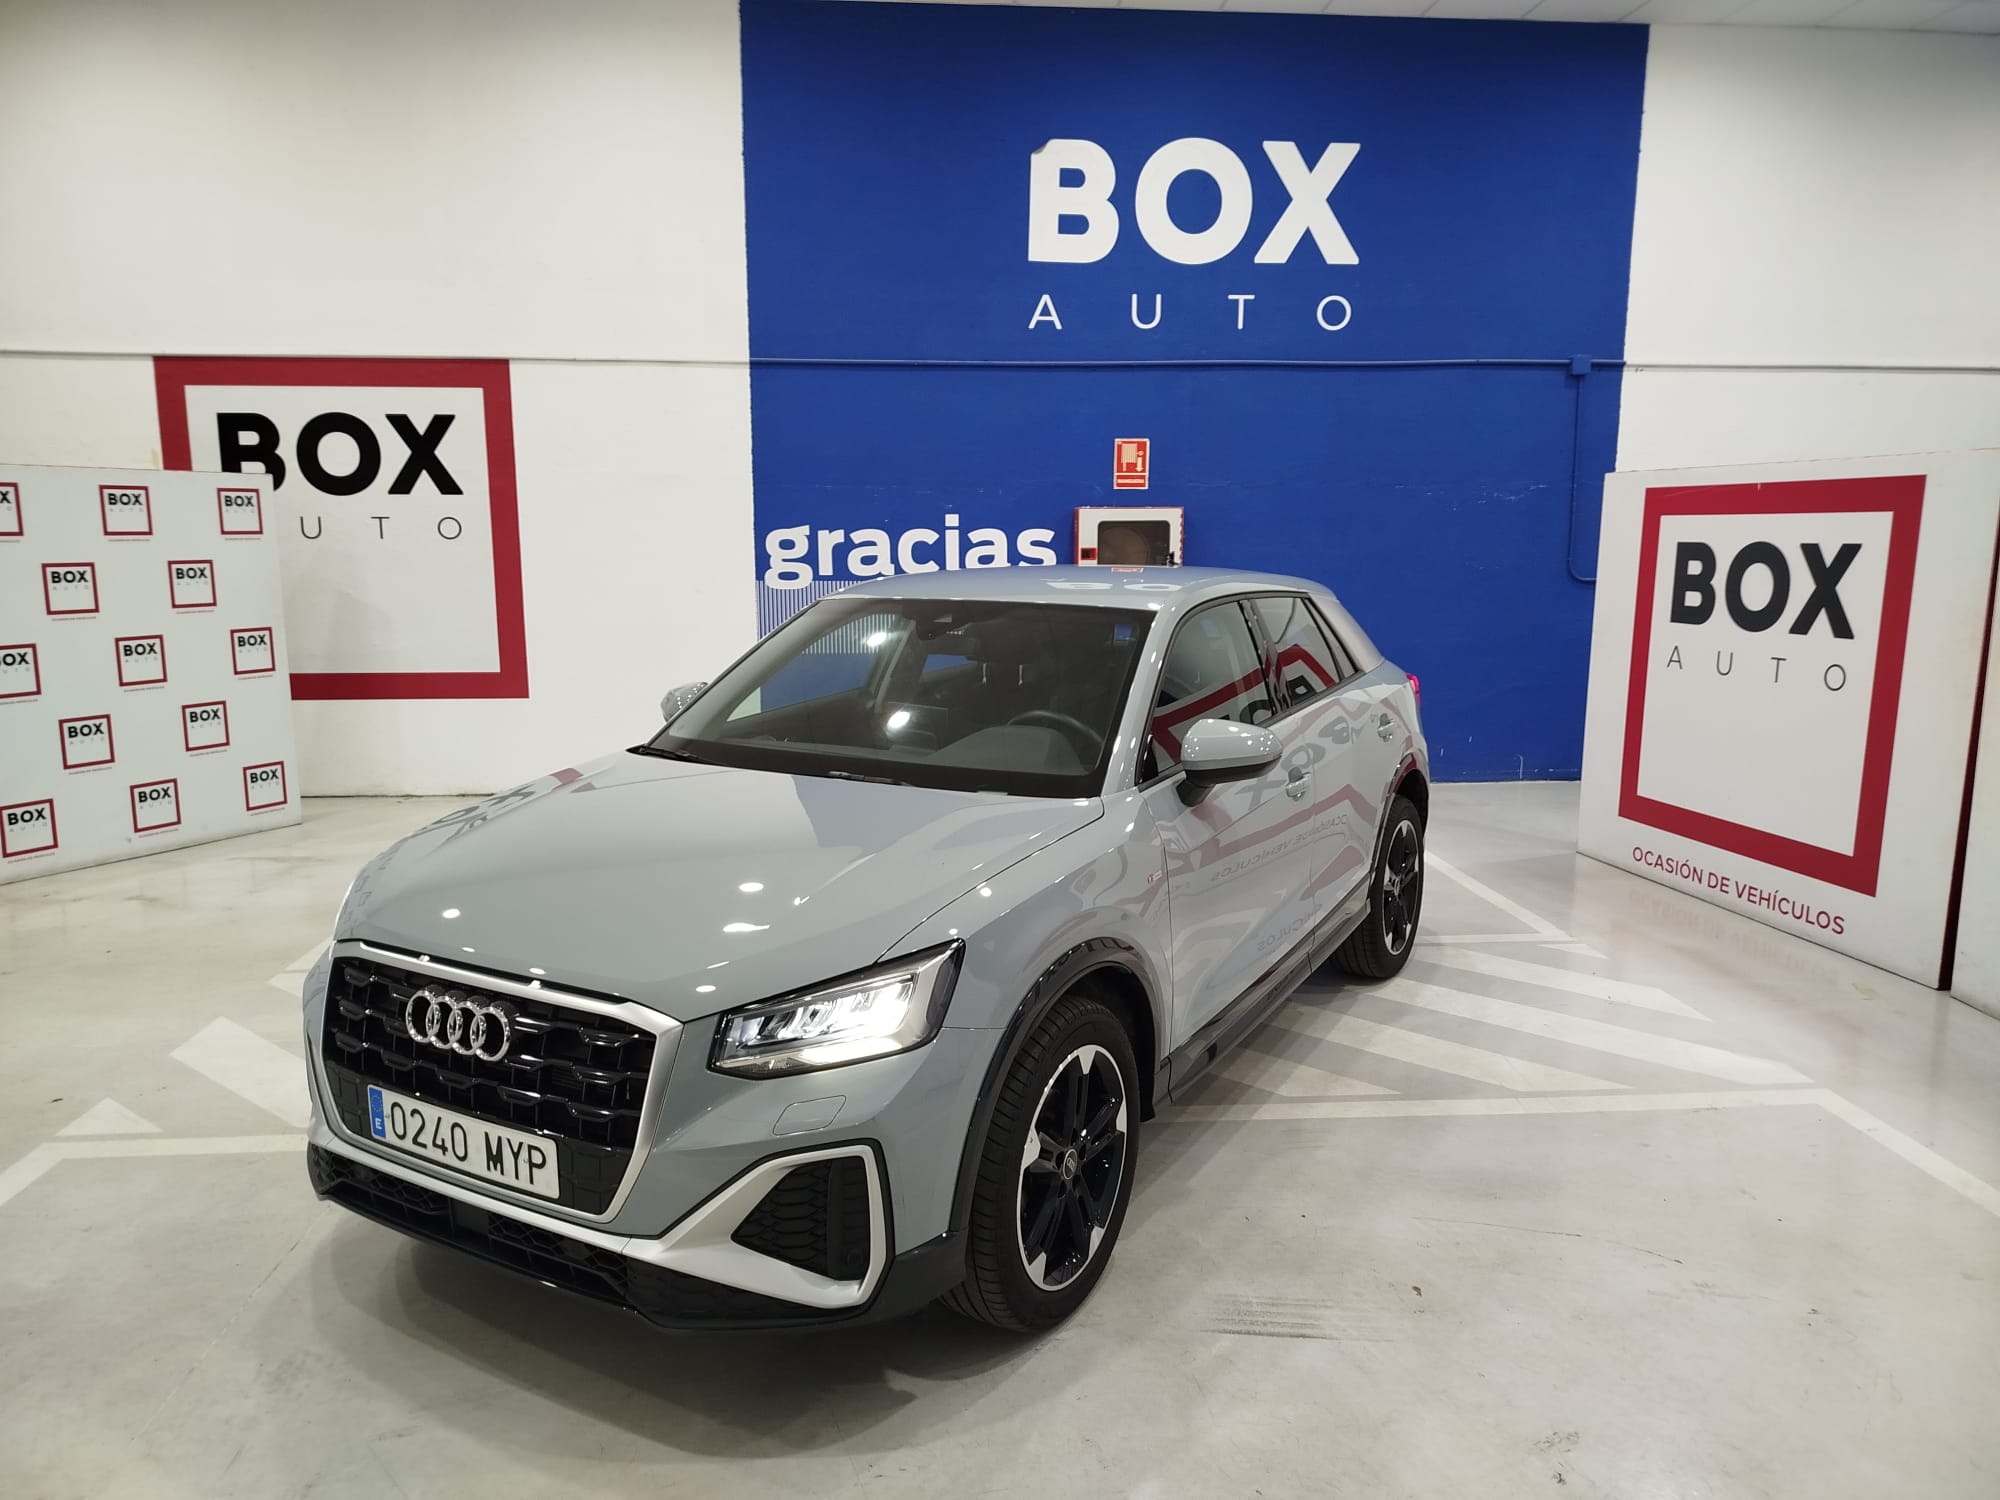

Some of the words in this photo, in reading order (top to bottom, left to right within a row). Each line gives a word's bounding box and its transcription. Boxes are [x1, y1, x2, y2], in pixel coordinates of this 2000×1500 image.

[1028, 137, 1361, 265] BOX
[1028, 293, 1352, 331] AUTO
[216, 412, 464, 496] BOX
[107, 492, 144, 506] BOX
[224, 495, 255, 508] BOX
[300, 516, 462, 540] UTO
[763, 514, 1058, 590] gracias
[50, 570, 89, 584] BOX
[175, 567, 208, 580] BOX
[1670, 541, 1863, 640] BOX
[237, 633, 267, 647] BOX
[122, 642, 158, 657] BOX
[0, 651, 30, 667] OX
[1666, 645, 1847, 692] AUTO
[188, 707, 221, 723] BOX
[67, 721, 105, 739] BOX
[248, 767, 280, 784] BOX
[137, 785, 172, 803] BOX
[7, 807, 47, 826] BOX
[1632, 846, 1704, 885] OCASIÓN
[1707, 871, 1731, 895] DE
[1734, 880, 1846, 936] VEHÍCULOS
[375, 1118, 383, 1130] E
[390, 1101, 469, 1164] 0240
[484, 1131, 548, 1186] MYP
